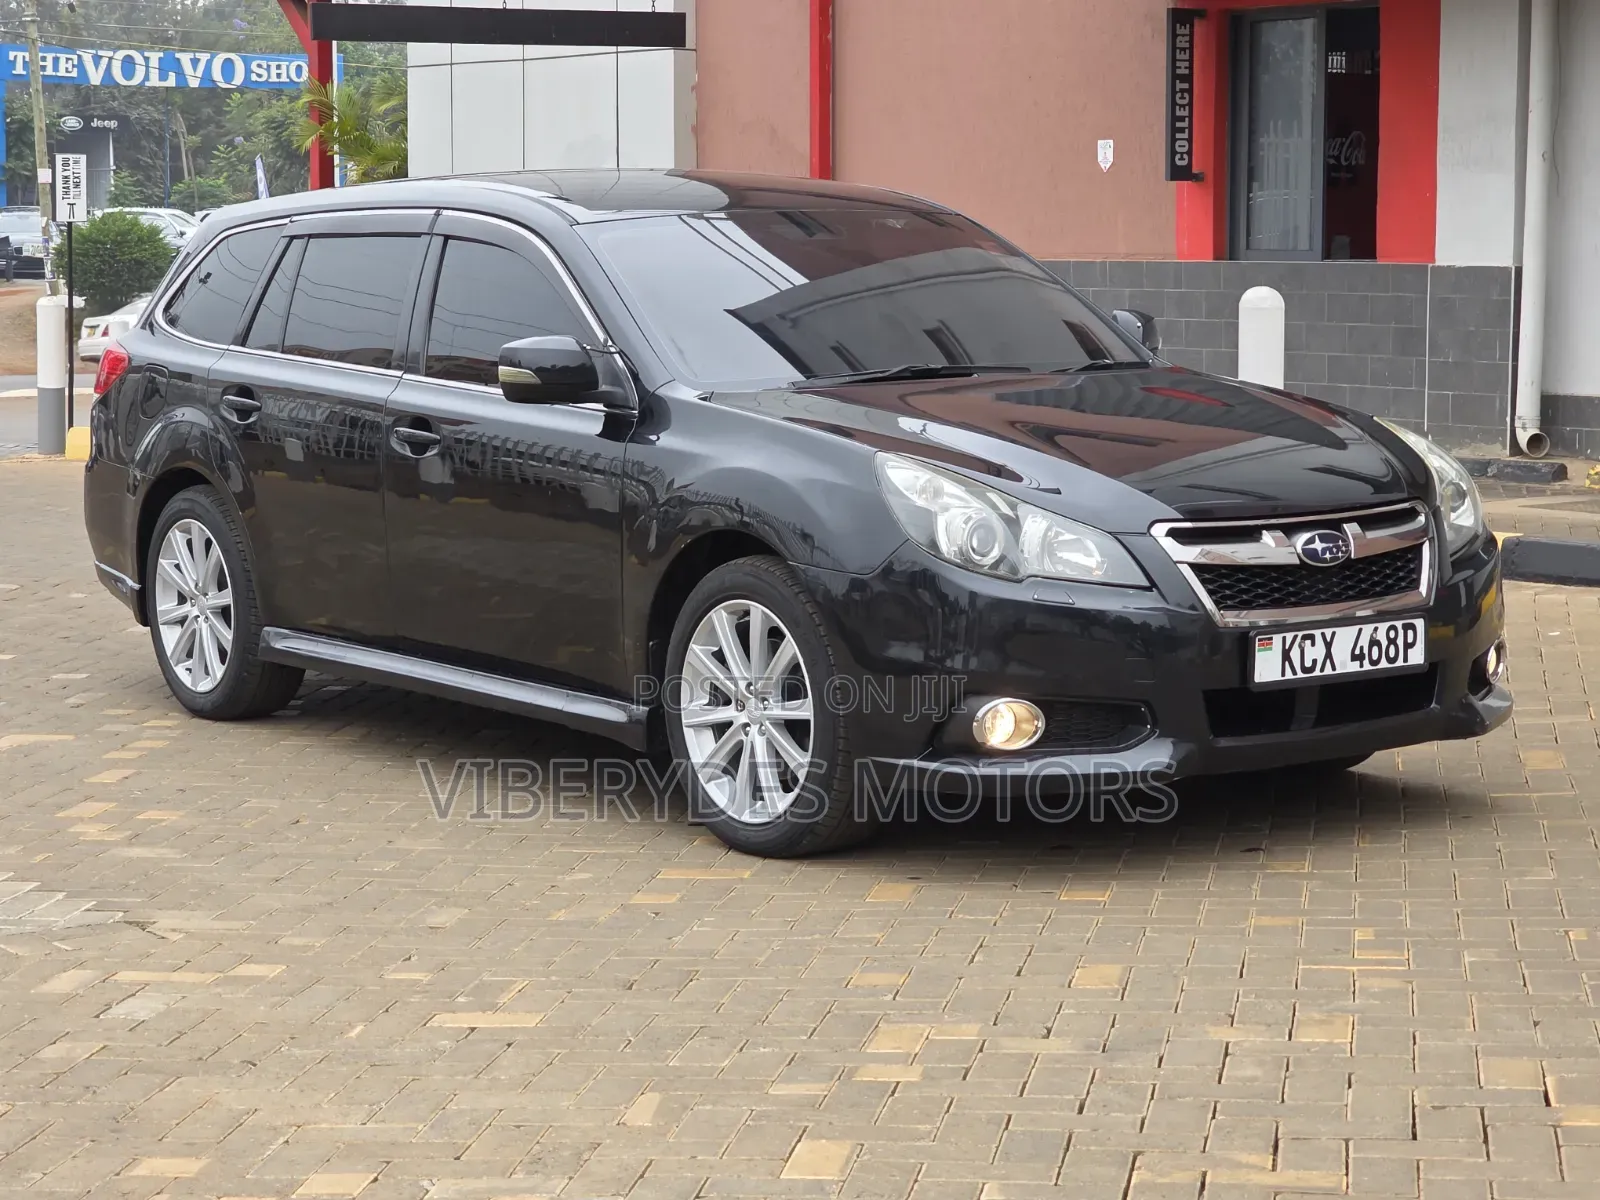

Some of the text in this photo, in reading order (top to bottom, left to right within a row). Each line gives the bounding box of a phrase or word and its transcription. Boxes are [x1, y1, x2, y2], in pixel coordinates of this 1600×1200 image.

[9, 50, 308, 88] THE VOLVO SHO
[1175, 23, 1190, 166] COLLECT HERE
[91, 118, 118, 129] Jeep
[62, 157, 71, 200] THANK YOU
[72, 156, 81, 170] TIME
[72, 171, 81, 190] NEXT
[1281, 622, 1418, 678] KCX 468P
